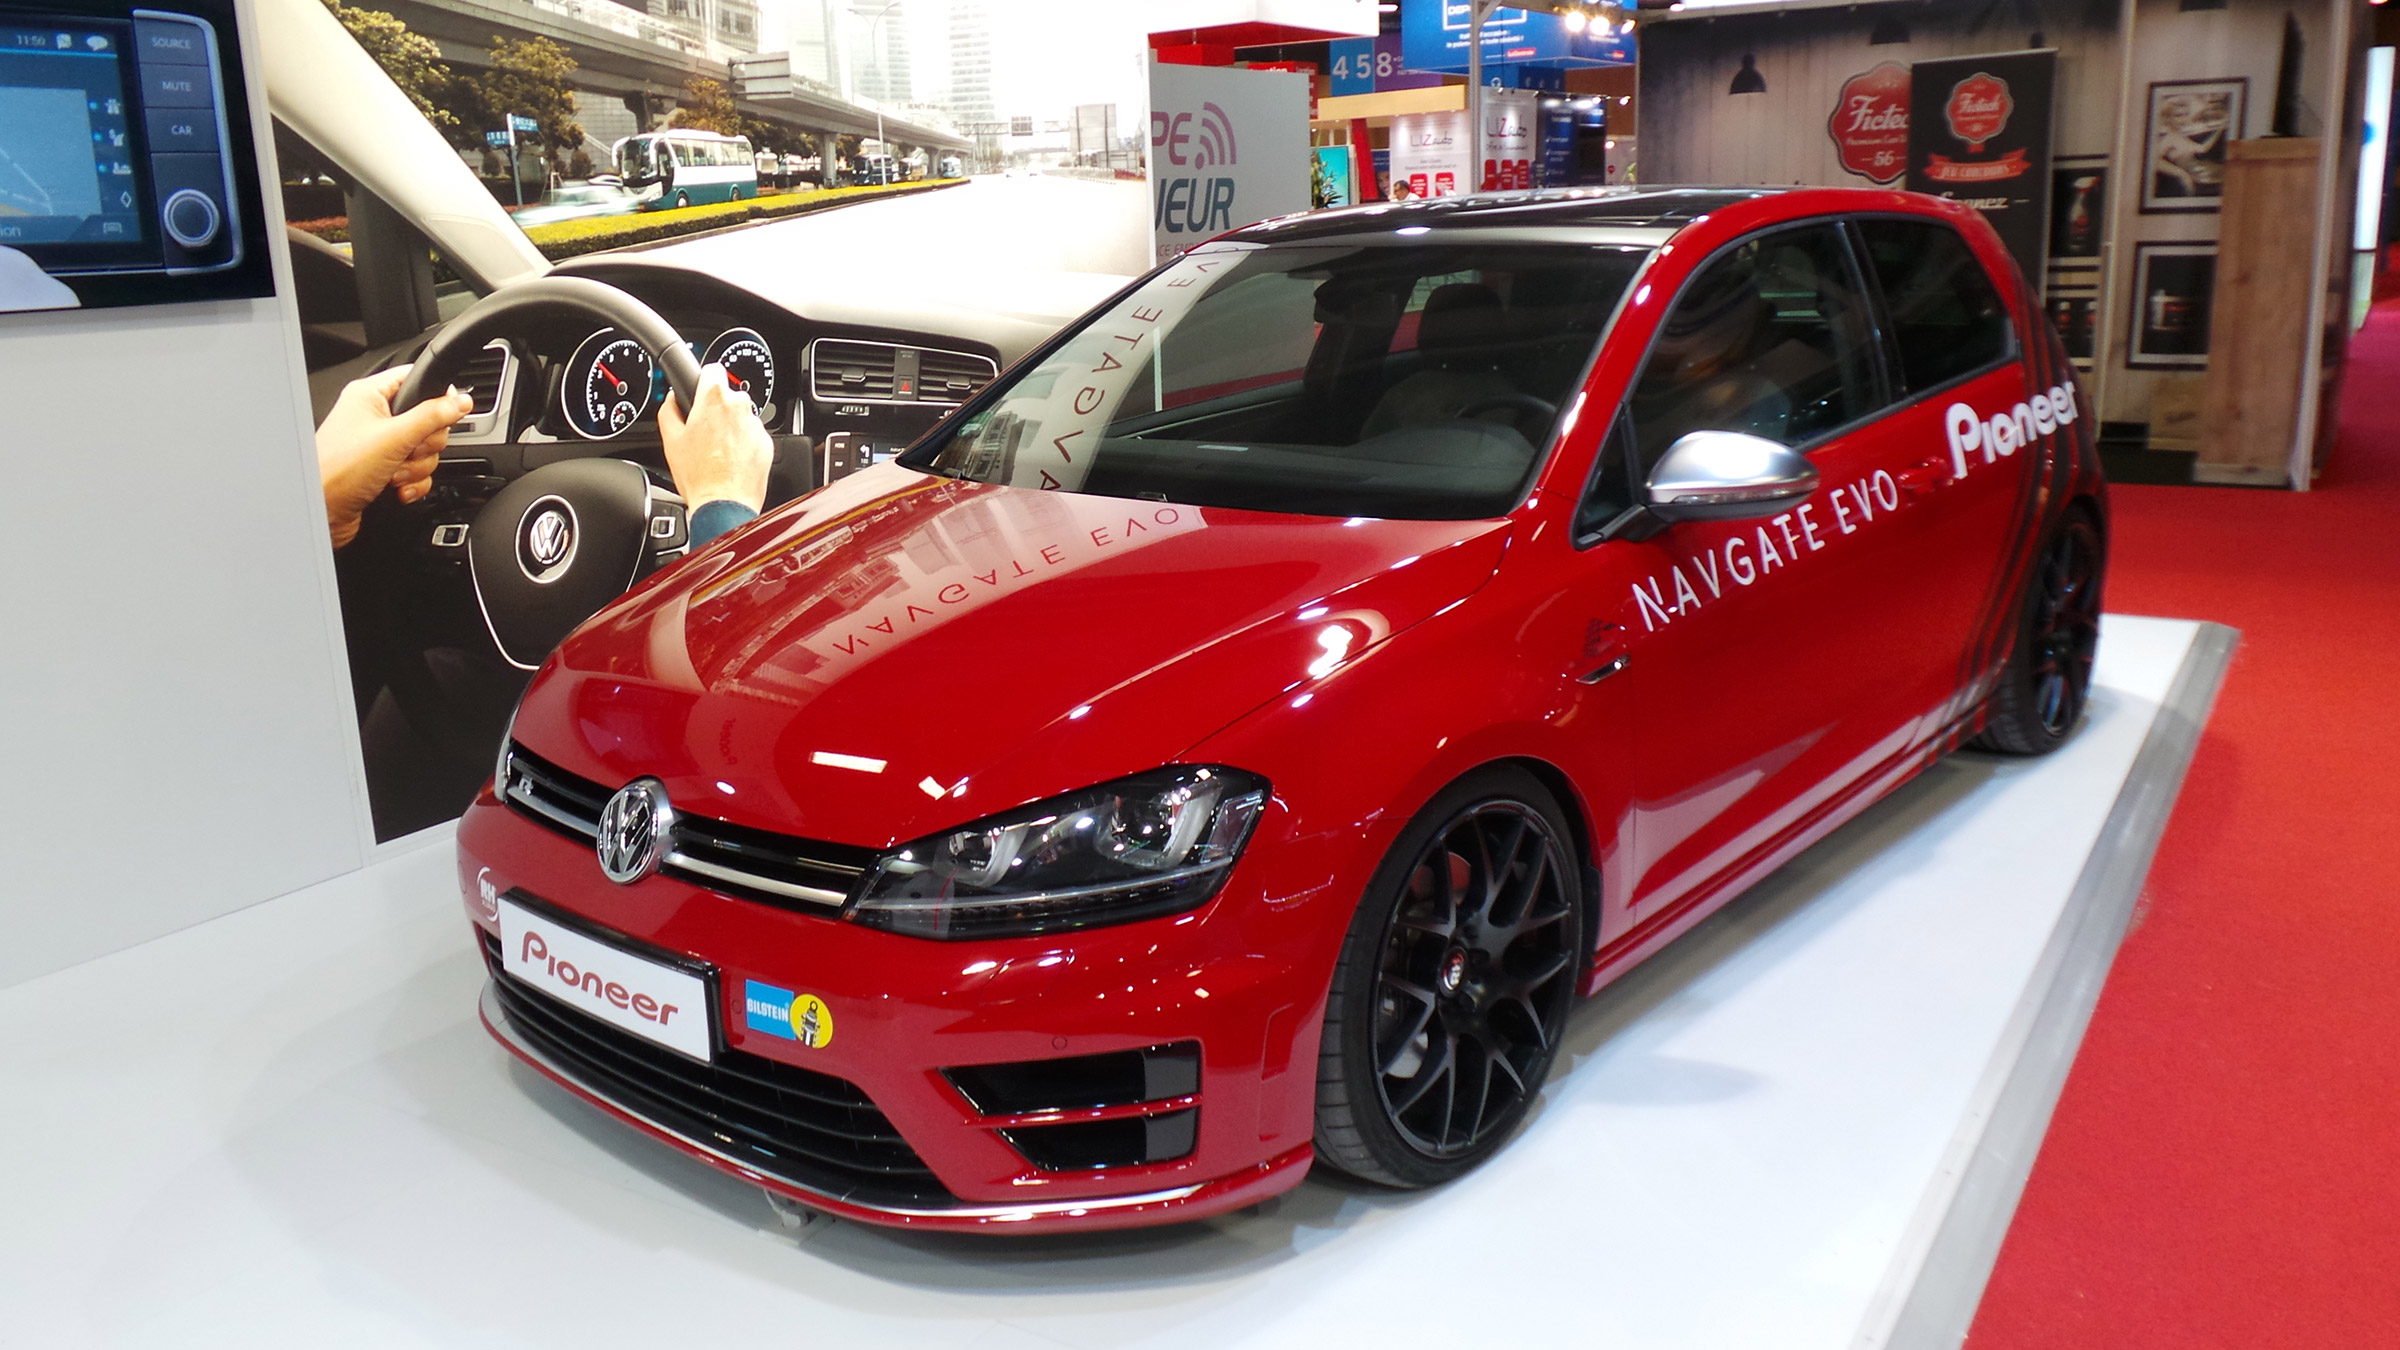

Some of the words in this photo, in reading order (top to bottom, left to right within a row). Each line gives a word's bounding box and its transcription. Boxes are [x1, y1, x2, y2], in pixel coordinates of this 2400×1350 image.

[152, 36, 191, 50] SOURCE
[1332, 55, 1349, 80] 4
[1356, 53, 1372, 79] 5
[1376, 52, 1393, 77] 8
[162, 80, 192, 93] MUTE
[171, 125, 193, 136] CAR
[1873, 150, 1895, 167] 56
[1945, 382, 2080, 479] Pioneer
[1631, 502, 1826, 633] NAVGATE
[1829, 469, 1899, 535] EVO
[521, 930, 679, 1026] Pioneer
[746, 998, 789, 1023] BILSTEIN
